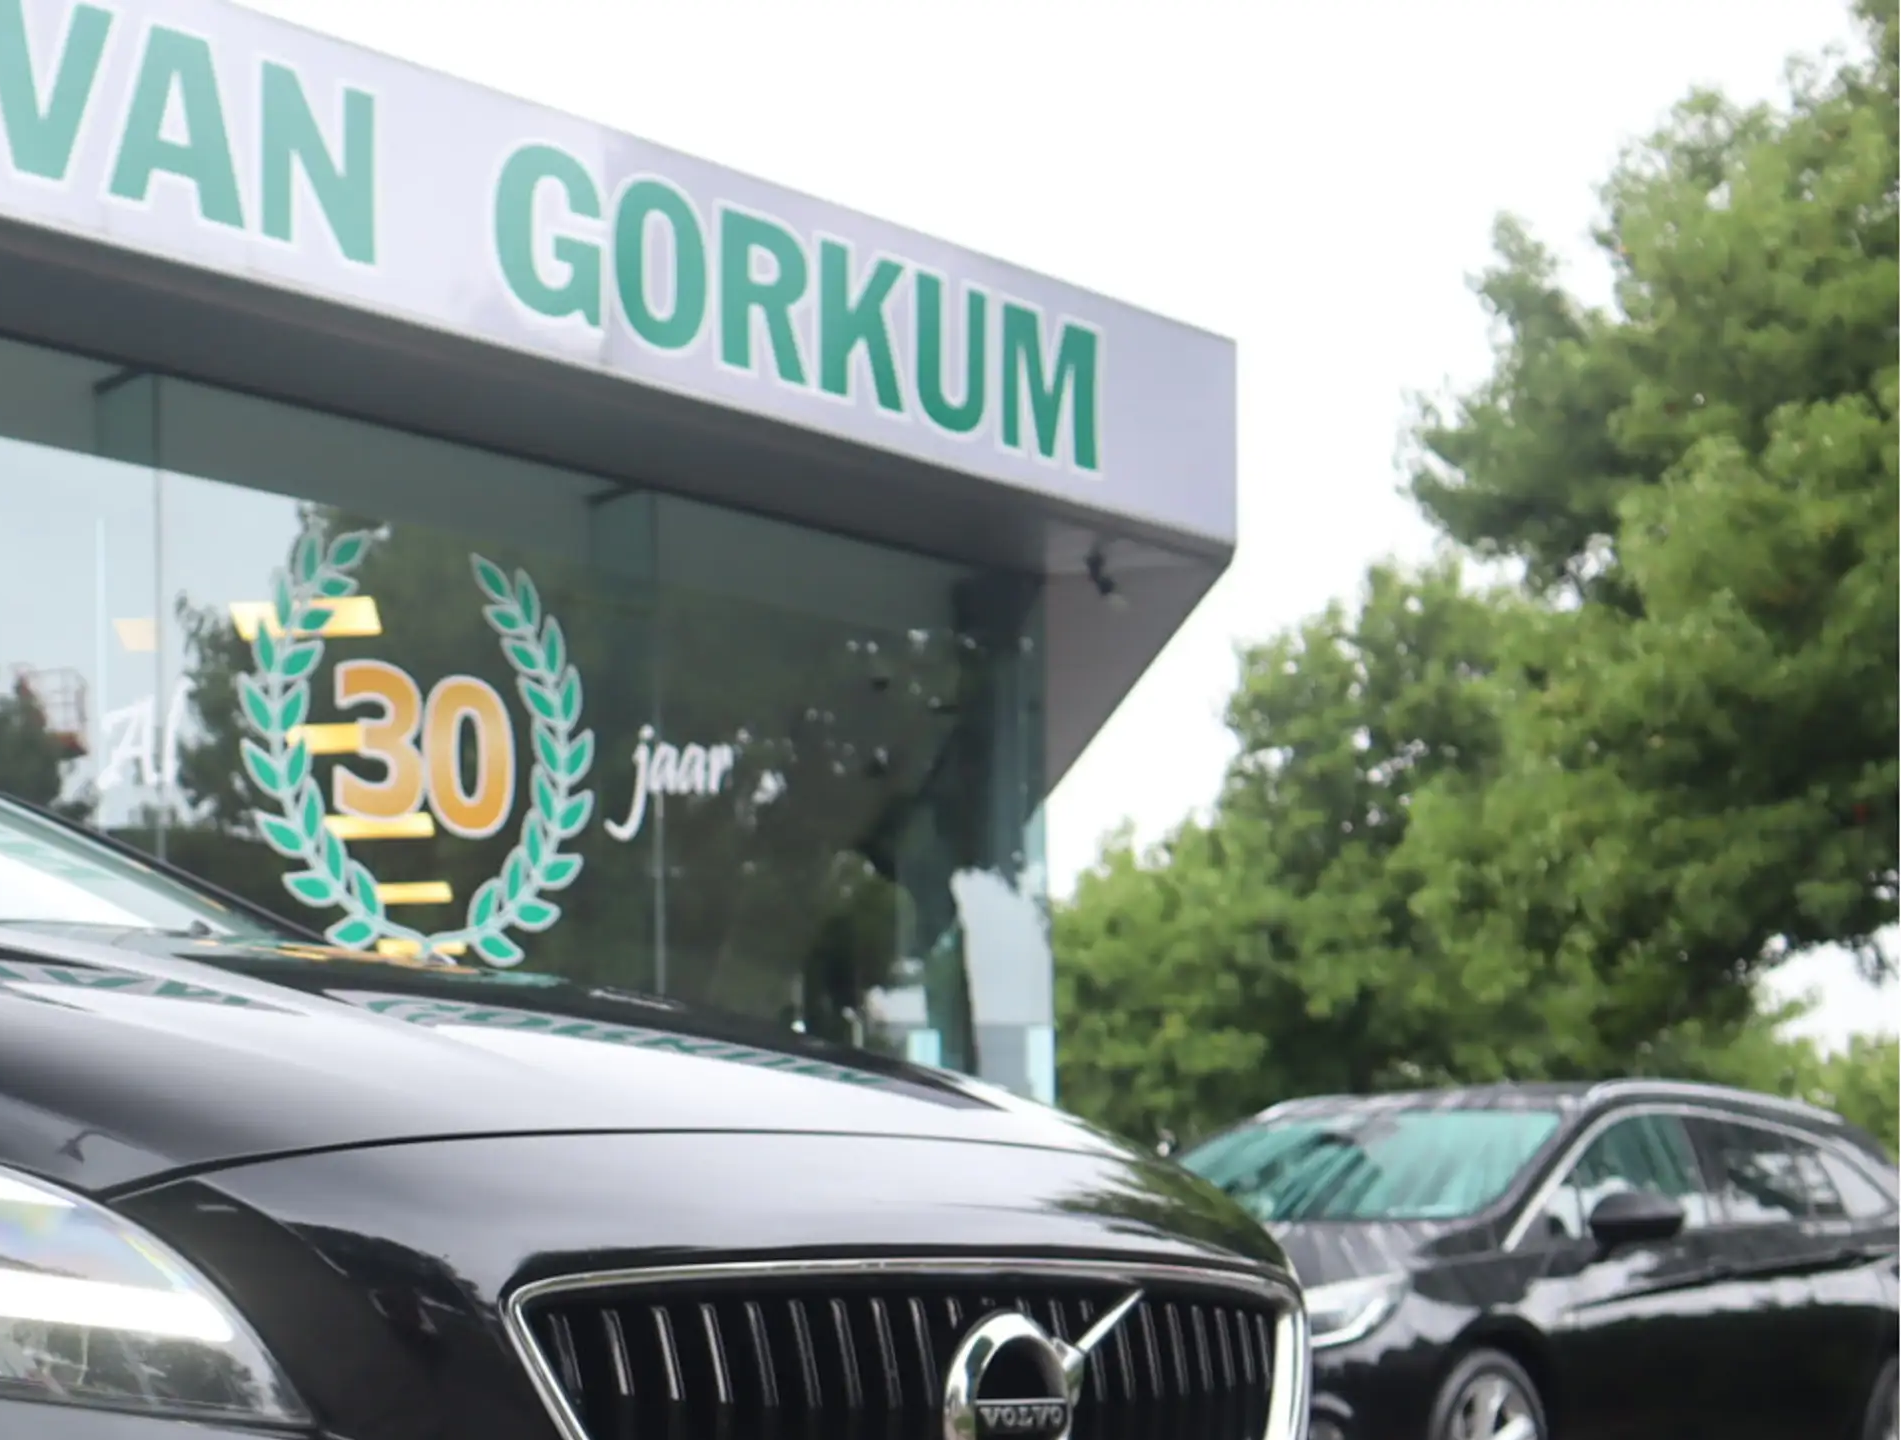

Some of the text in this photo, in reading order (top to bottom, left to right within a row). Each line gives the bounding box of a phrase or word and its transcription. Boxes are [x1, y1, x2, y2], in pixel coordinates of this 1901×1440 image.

[493, 145, 1099, 472] GORKUM
[333, 661, 514, 839] 30
[604, 725, 733, 842] jaar
[980, 1405, 1064, 1428] VOLVO
